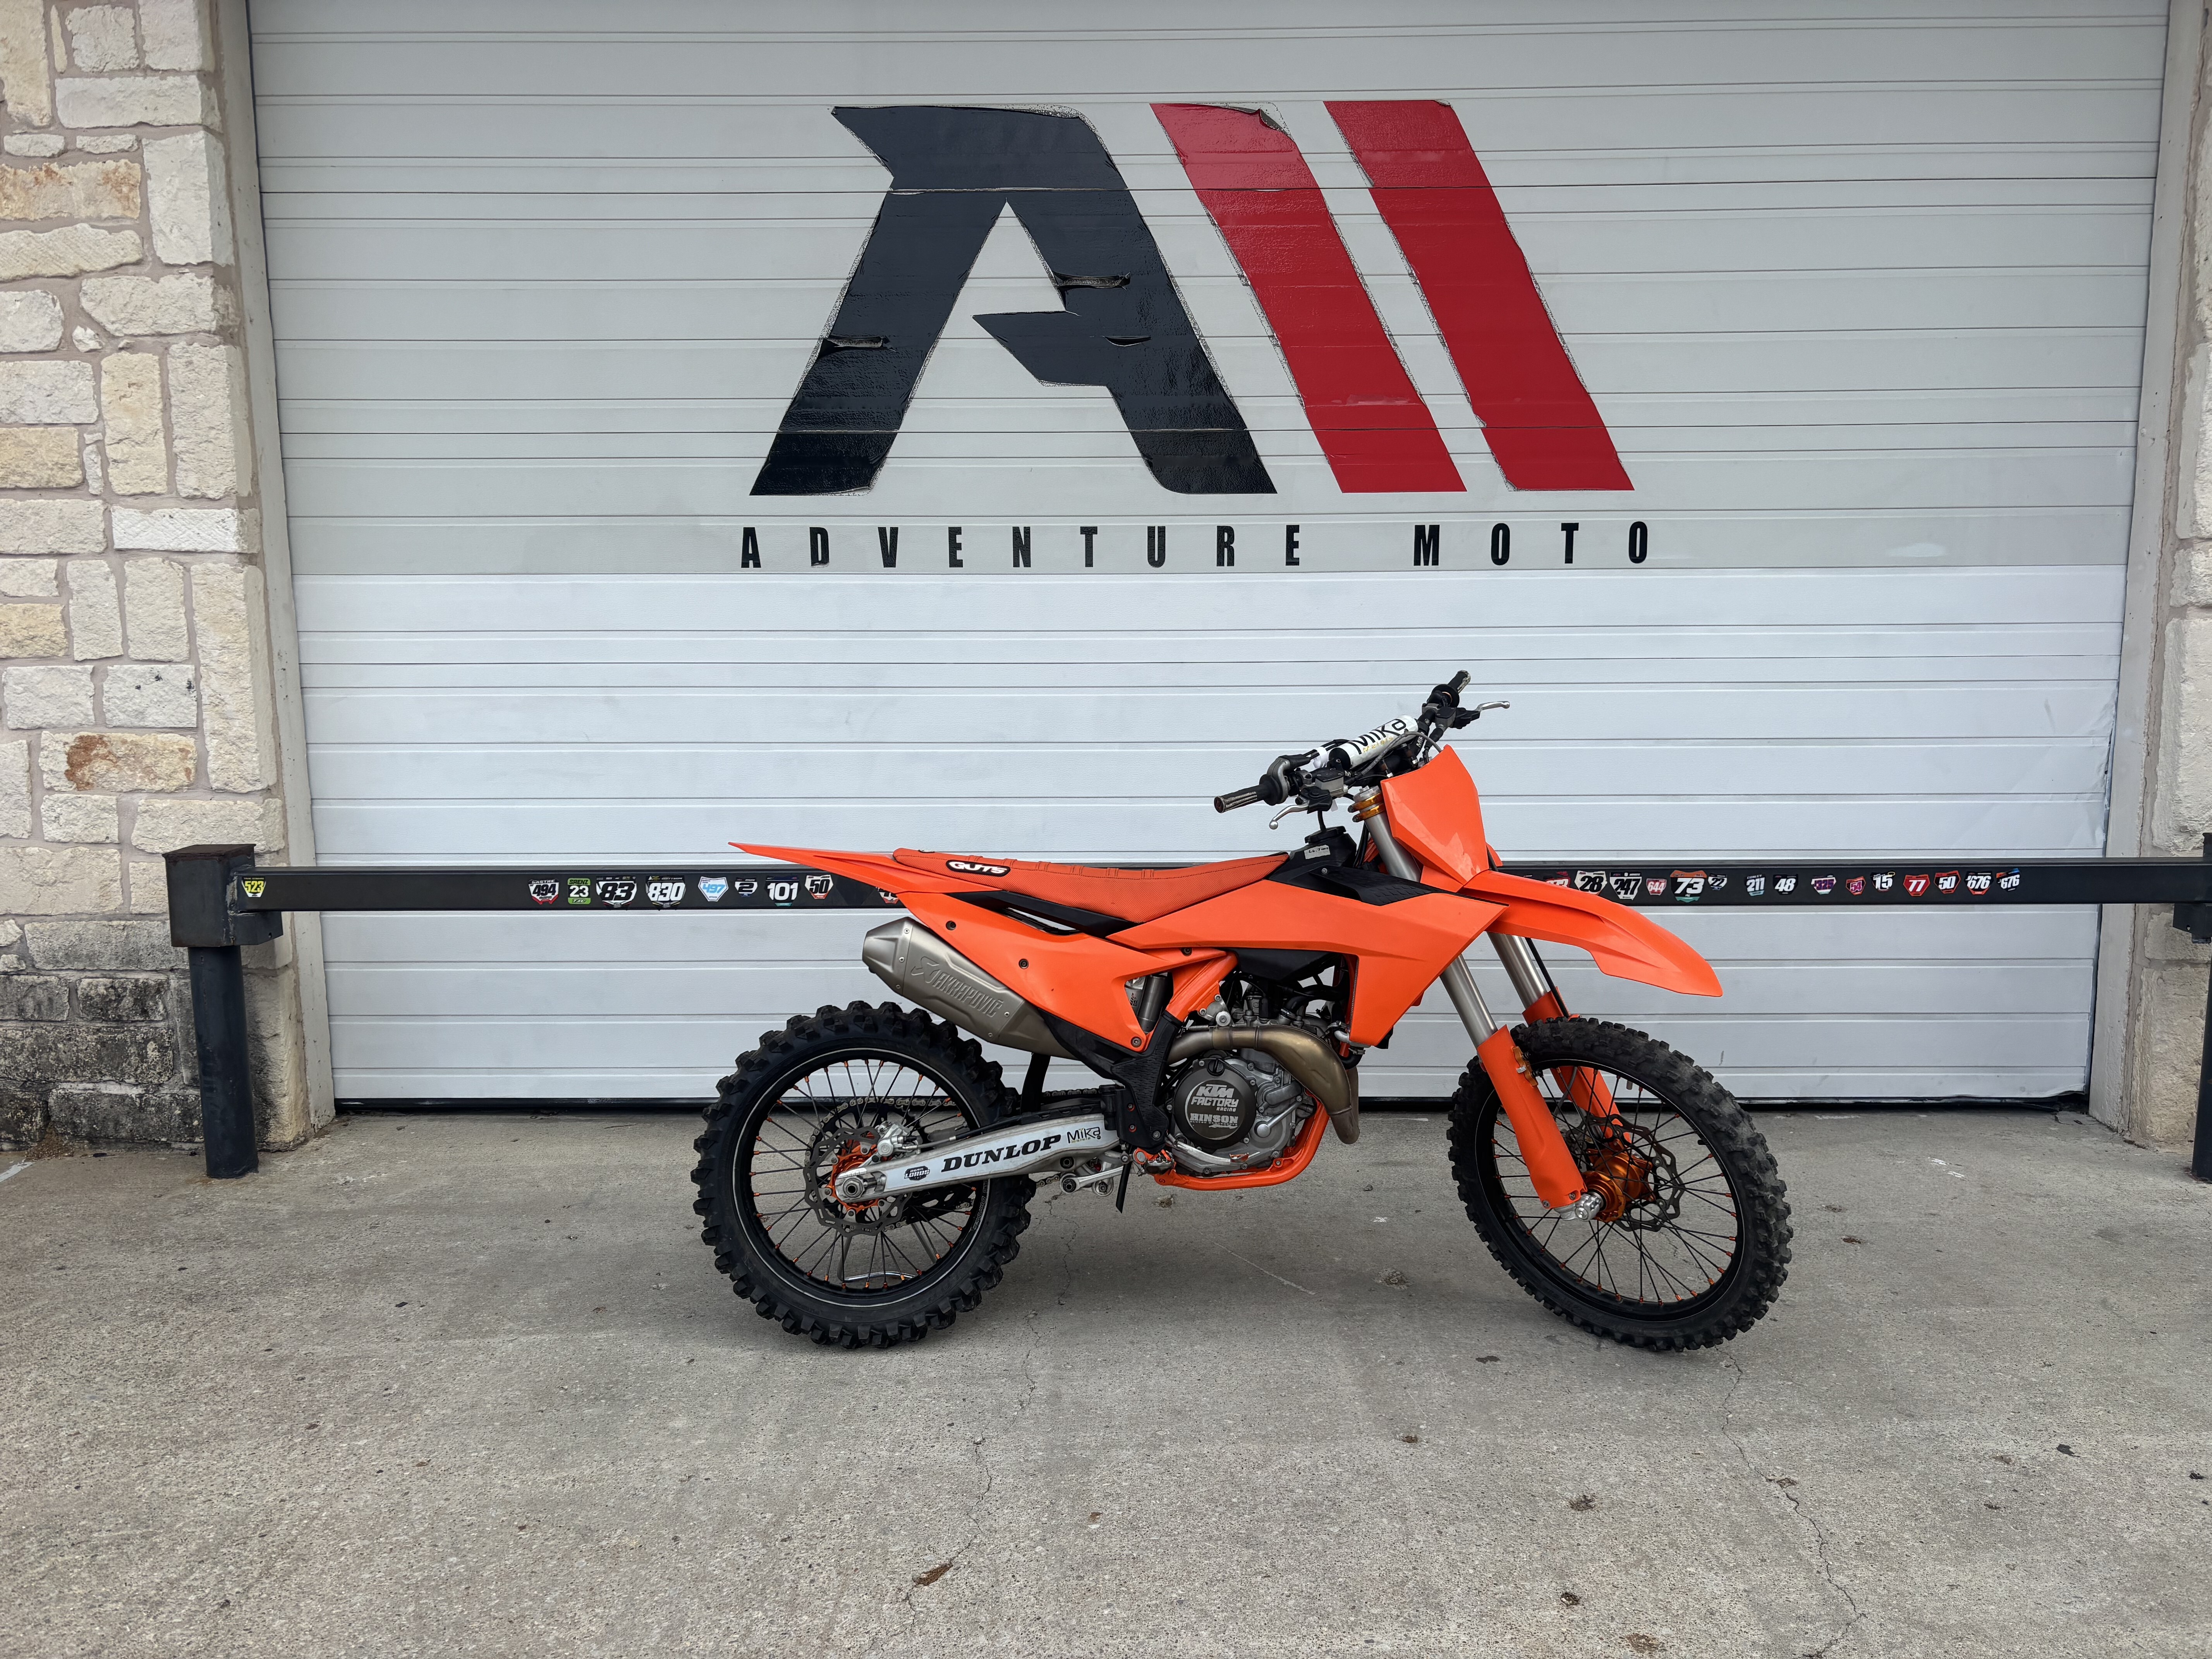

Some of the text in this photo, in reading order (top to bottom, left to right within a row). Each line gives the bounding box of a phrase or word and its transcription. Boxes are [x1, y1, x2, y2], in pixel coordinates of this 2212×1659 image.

[741, 521, 1648, 568] ADVENTURE MOTO
[948, 862, 1008, 874] GUTS
[245, 881, 264, 892] 523
[702, 884, 725, 893] 497
[738, 883, 754, 892] 2
[809, 879, 830, 893] 50
[1579, 876, 1604, 892] 28
[1614, 878, 1641, 895] 247
[1647, 881, 1664, 892] 644
[1674, 878, 1705, 894] 73
[1746, 877, 1765, 892] 211
[1774, 878, 1796, 891] 48
[1850, 880, 1863, 893] 54
[1873, 874, 1893, 890] 15
[1908, 879, 1926, 892] 77
[1938, 876, 1956, 890] 50
[532, 884, 556, 896] 494
[570, 885, 589, 897] 23
[600, 883, 635, 901] 83
[647, 883, 685, 901] 830
[767, 883, 799, 900] 101
[1196, 1084, 1234, 1098] KTM
[1191, 1096, 1239, 1108] FACTORY
[1190, 1113, 1238, 1123] HINSON
[941, 1134, 1061, 1173] DUNLOP
[905, 1170, 929, 1178] LORDS
